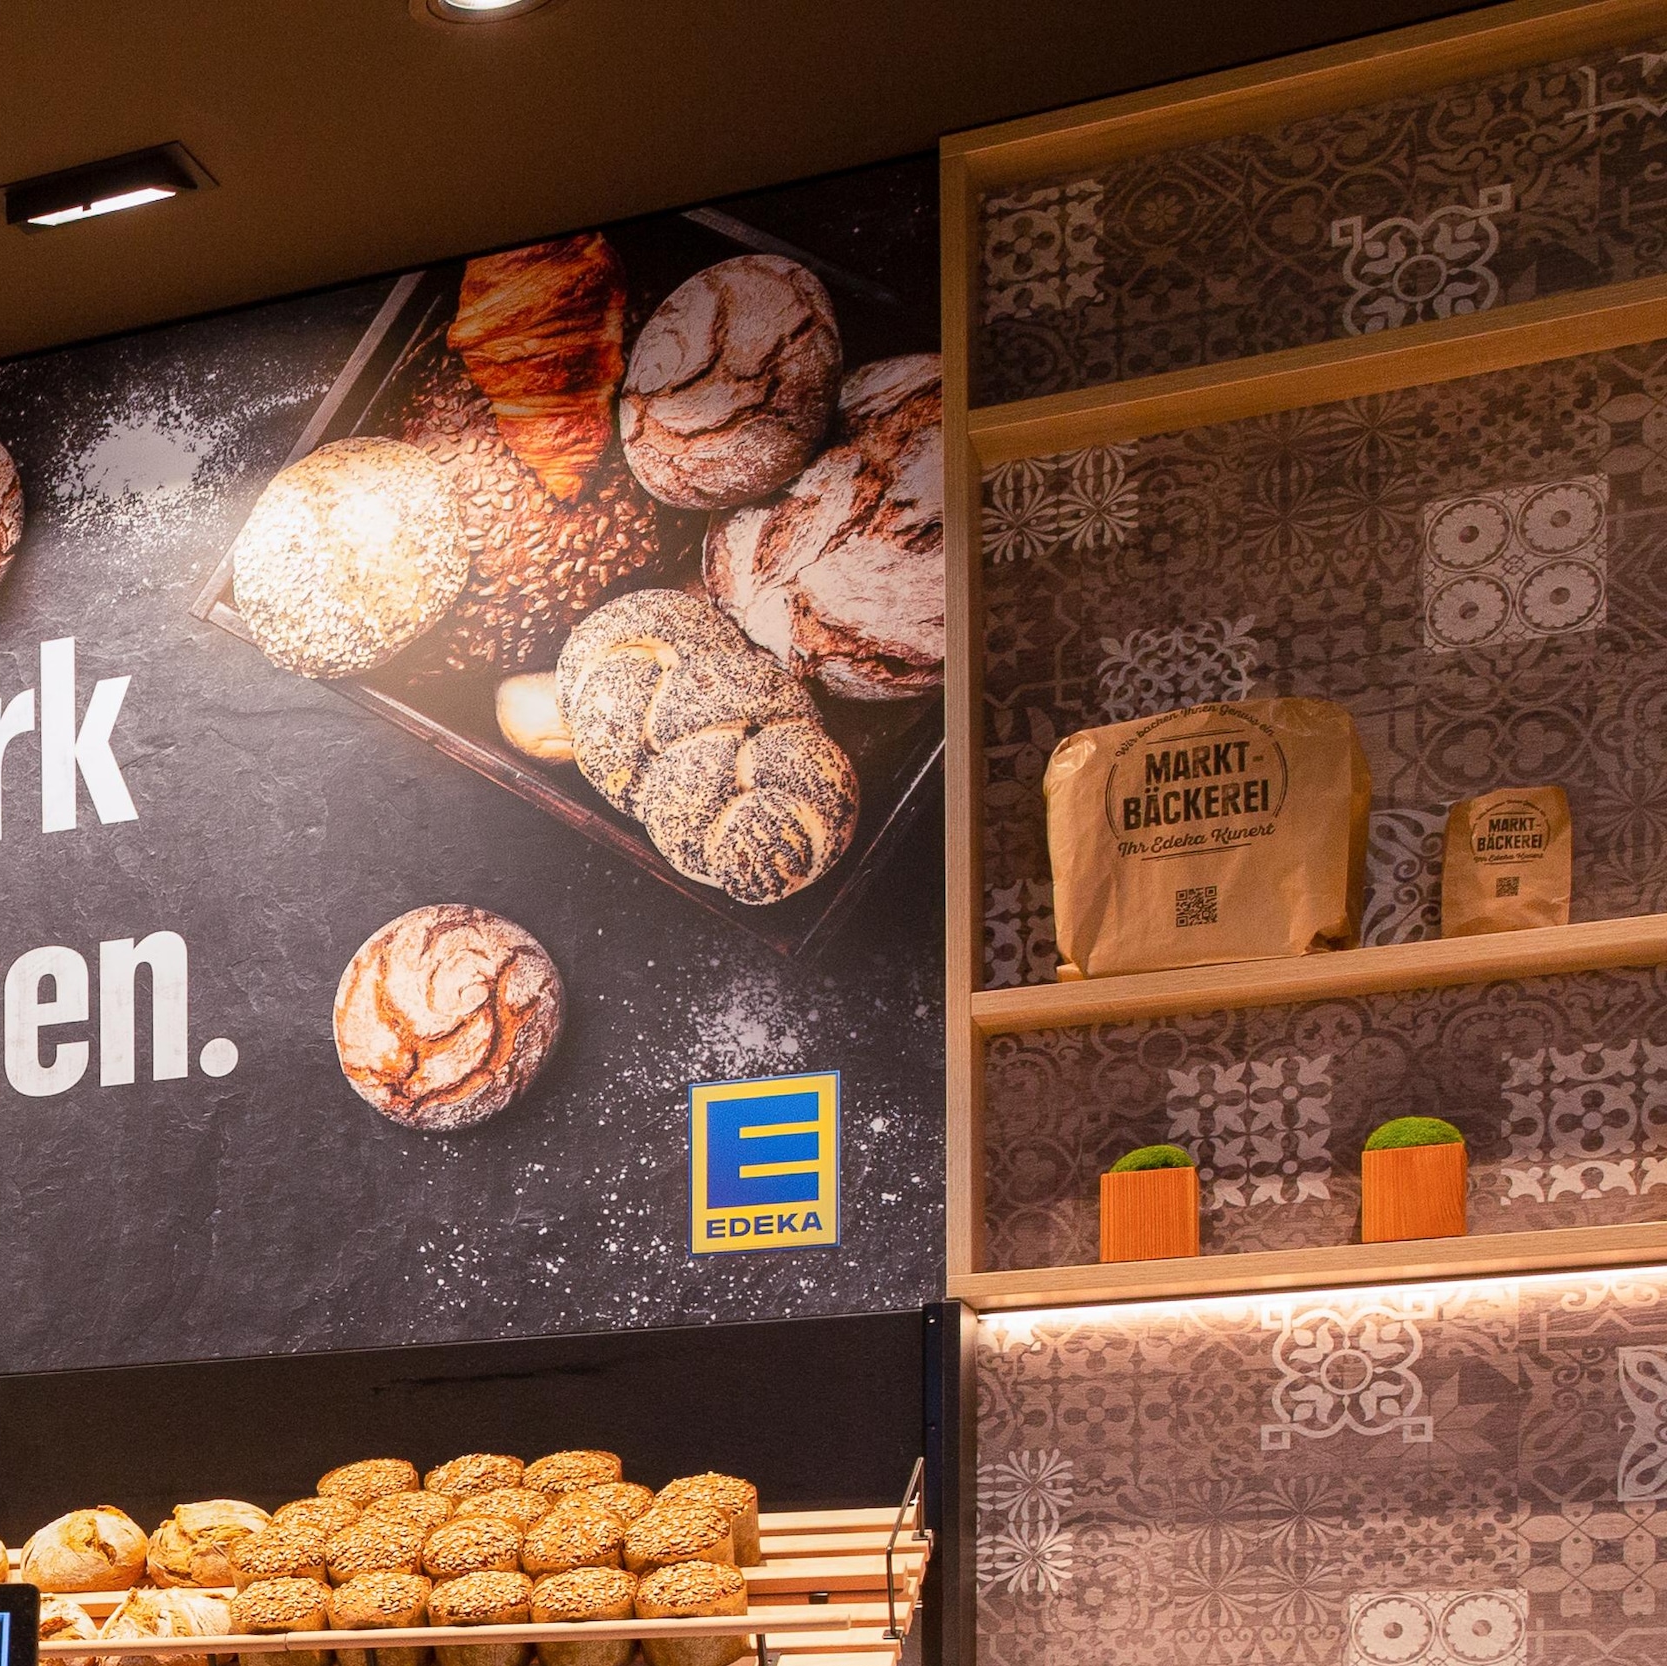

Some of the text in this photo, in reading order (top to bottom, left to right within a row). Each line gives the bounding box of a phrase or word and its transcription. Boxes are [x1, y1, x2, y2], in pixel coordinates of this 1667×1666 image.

[1145, 740, 1265, 786] MARKT-
[1123, 779, 1270, 831] BÄCKEREI
[1118, 822, 1276, 858] Ihr Edeka Kunert
[1489, 817, 1542, 832] MARKT-
[1477, 834, 1543, 852] BÄCKEREI
[706, 1091, 819, 1210] E
[705, 1210, 824, 1239] EDEKA
